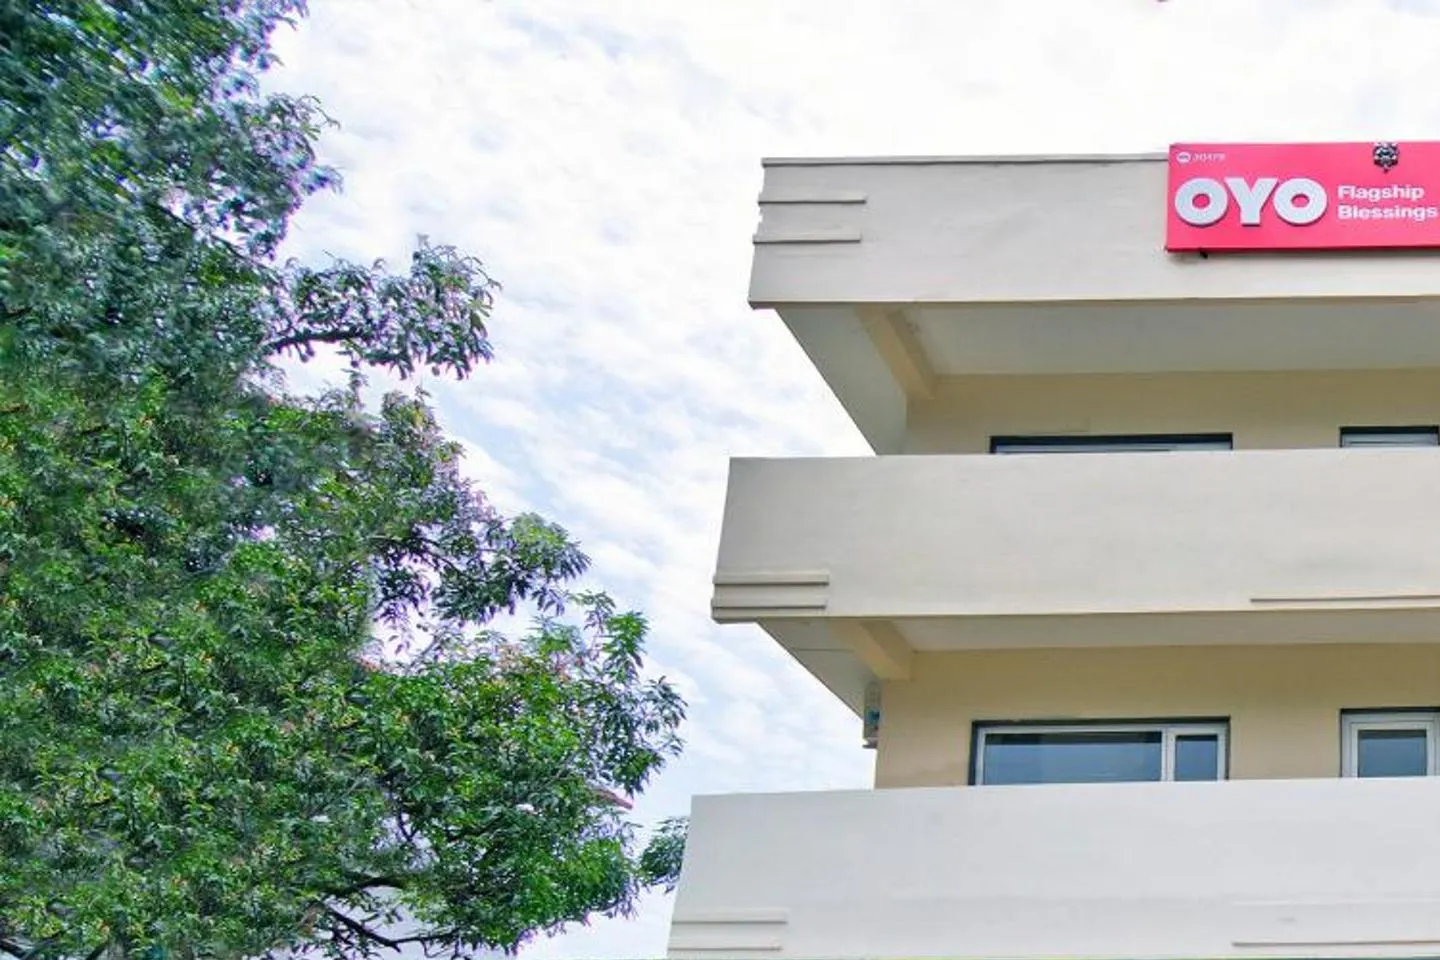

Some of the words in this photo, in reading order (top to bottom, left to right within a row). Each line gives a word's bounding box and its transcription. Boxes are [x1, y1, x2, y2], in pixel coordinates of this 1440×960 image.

[1174, 177, 1327, 226] OYO
[1337, 184, 1425, 201] Flagship
[1337, 204, 1438, 222] Blessings
